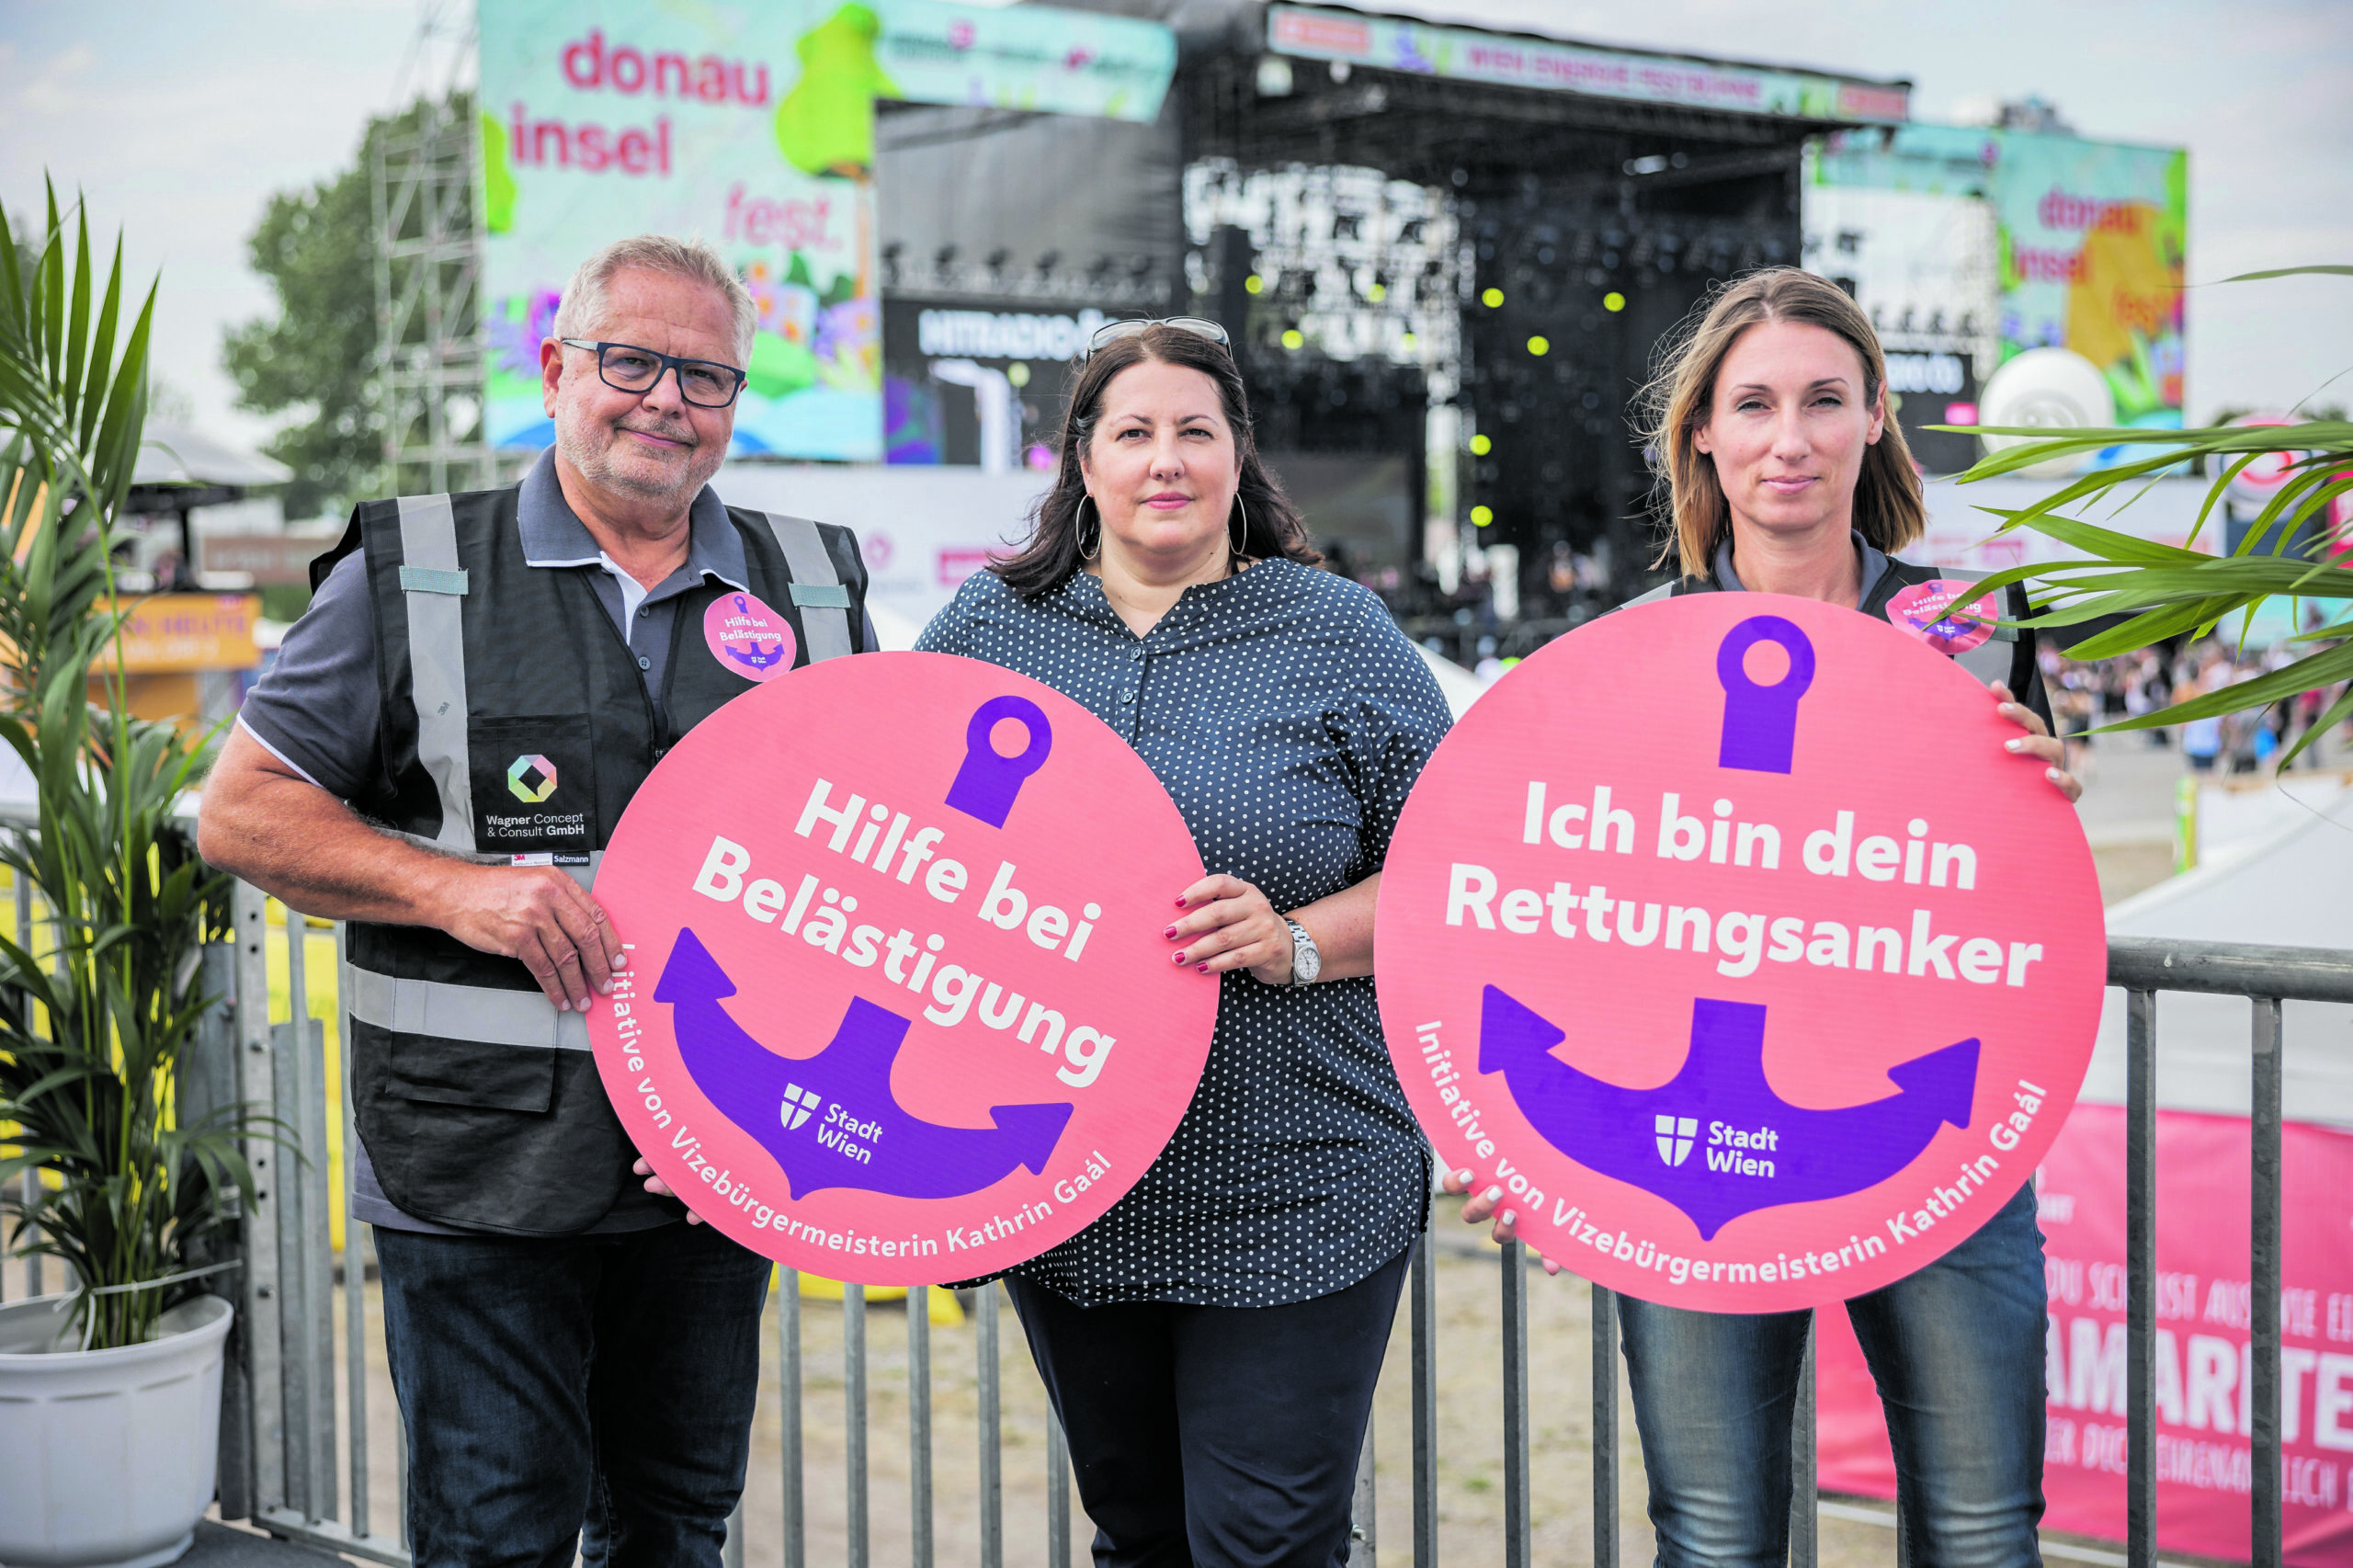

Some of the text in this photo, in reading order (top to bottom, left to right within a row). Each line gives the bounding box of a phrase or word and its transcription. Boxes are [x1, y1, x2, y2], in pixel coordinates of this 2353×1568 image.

[563, 28, 770, 107] donau
[511, 101, 671, 175] insel
[1912, 591, 1967, 607] Hilfe be
[719, 630, 782, 642] Belästigung
[724, 616, 768, 628] Hilfe bei
[486, 812, 585, 827] Wagner Concept
[487, 824, 585, 837] & Consult GmbH
[1522, 780, 1977, 891] Ich bin dein
[553, 855, 589, 863] Salzmann
[794, 778, 1102, 962] Hilfe bei
[1445, 862, 2043, 987] Rettungsanker
[691, 835, 1117, 1088] Belästigung
[612, 943, 1111, 1257] Iitiative von Vizebürgermeisterin Kathrin Gaál
[824, 1103, 883, 1143] Stadt
[1708, 1120, 1779, 1151] Stadt
[817, 1123, 871, 1165] Wien
[1415, 1020, 2046, 1285] Initiative von Vizebürgermeisterin Kathrin Gaál
[1706, 1147, 1775, 1177] Wien
